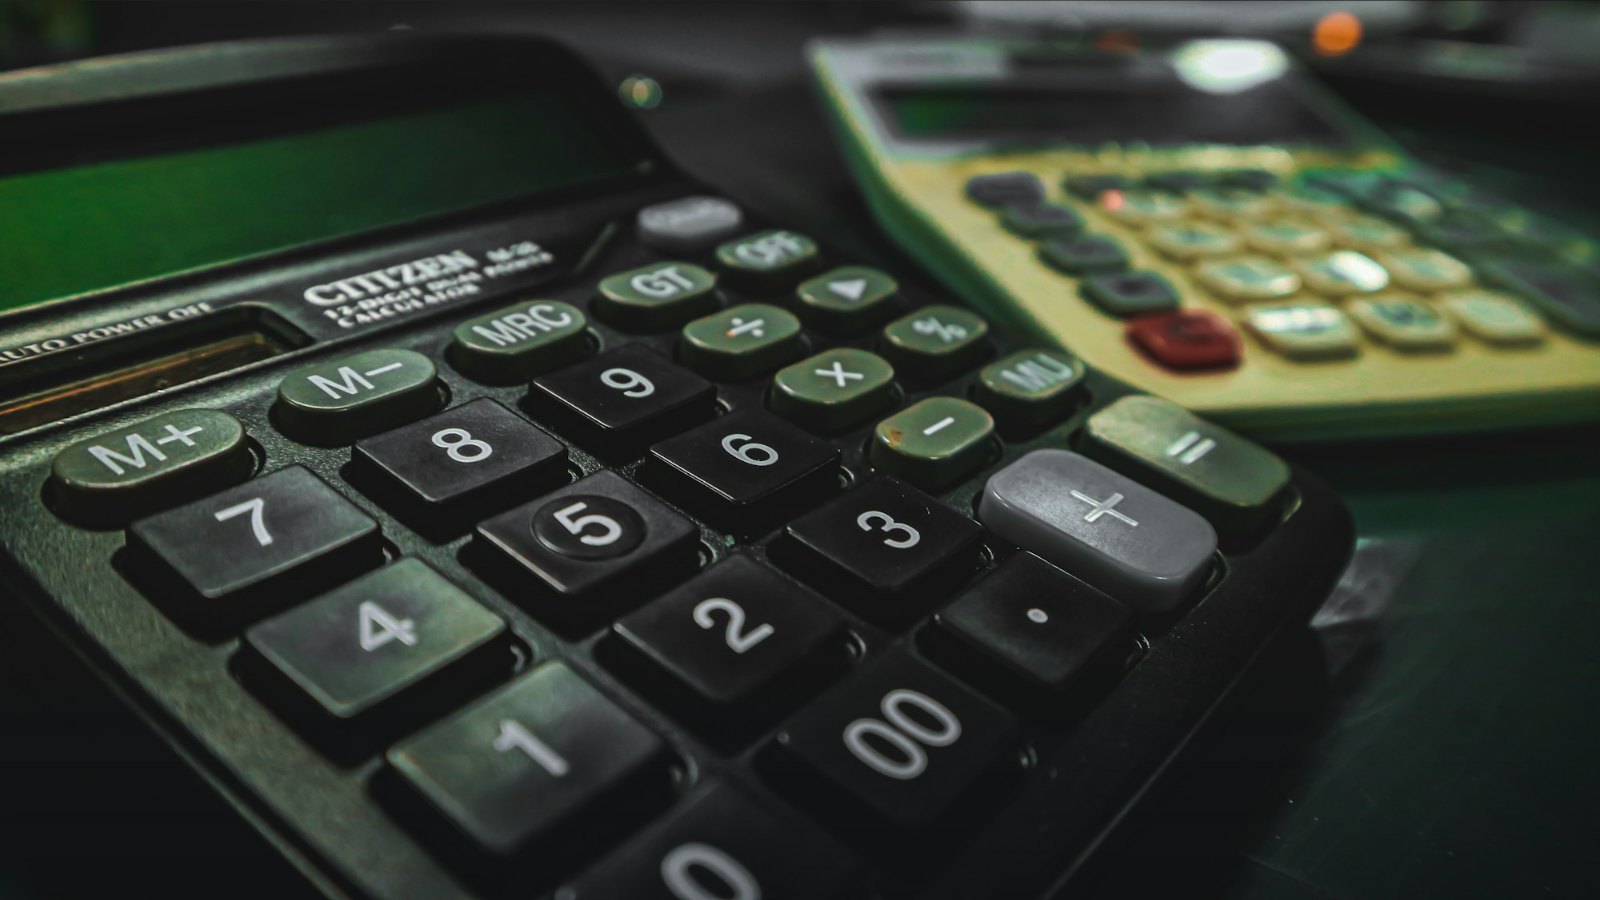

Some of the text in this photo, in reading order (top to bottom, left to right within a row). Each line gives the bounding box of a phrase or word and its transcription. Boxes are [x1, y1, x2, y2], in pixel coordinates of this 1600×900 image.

[735, 231, 802, 268] OFF
[304, 250, 478, 306] CITIZEN
[631, 266, 695, 298] GT
[71, 314, 164, 345] POWER
[472, 303, 573, 347] MRC
[600, 367, 656, 398] 9
[1001, 353, 1074, 391] MU
[87, 422, 204, 476] M+
[431, 427, 493, 463] 8
[721, 433, 779, 467] 6
[213, 497, 274, 548] 7
[552, 501, 623, 547] 5
[856, 510, 921, 549] 3
[358, 600, 418, 652] 4
[692, 597, 775, 654] 2
[493, 718, 568, 776] 1
[842, 688, 962, 780] 00
[660, 843, 762, 900] 0
